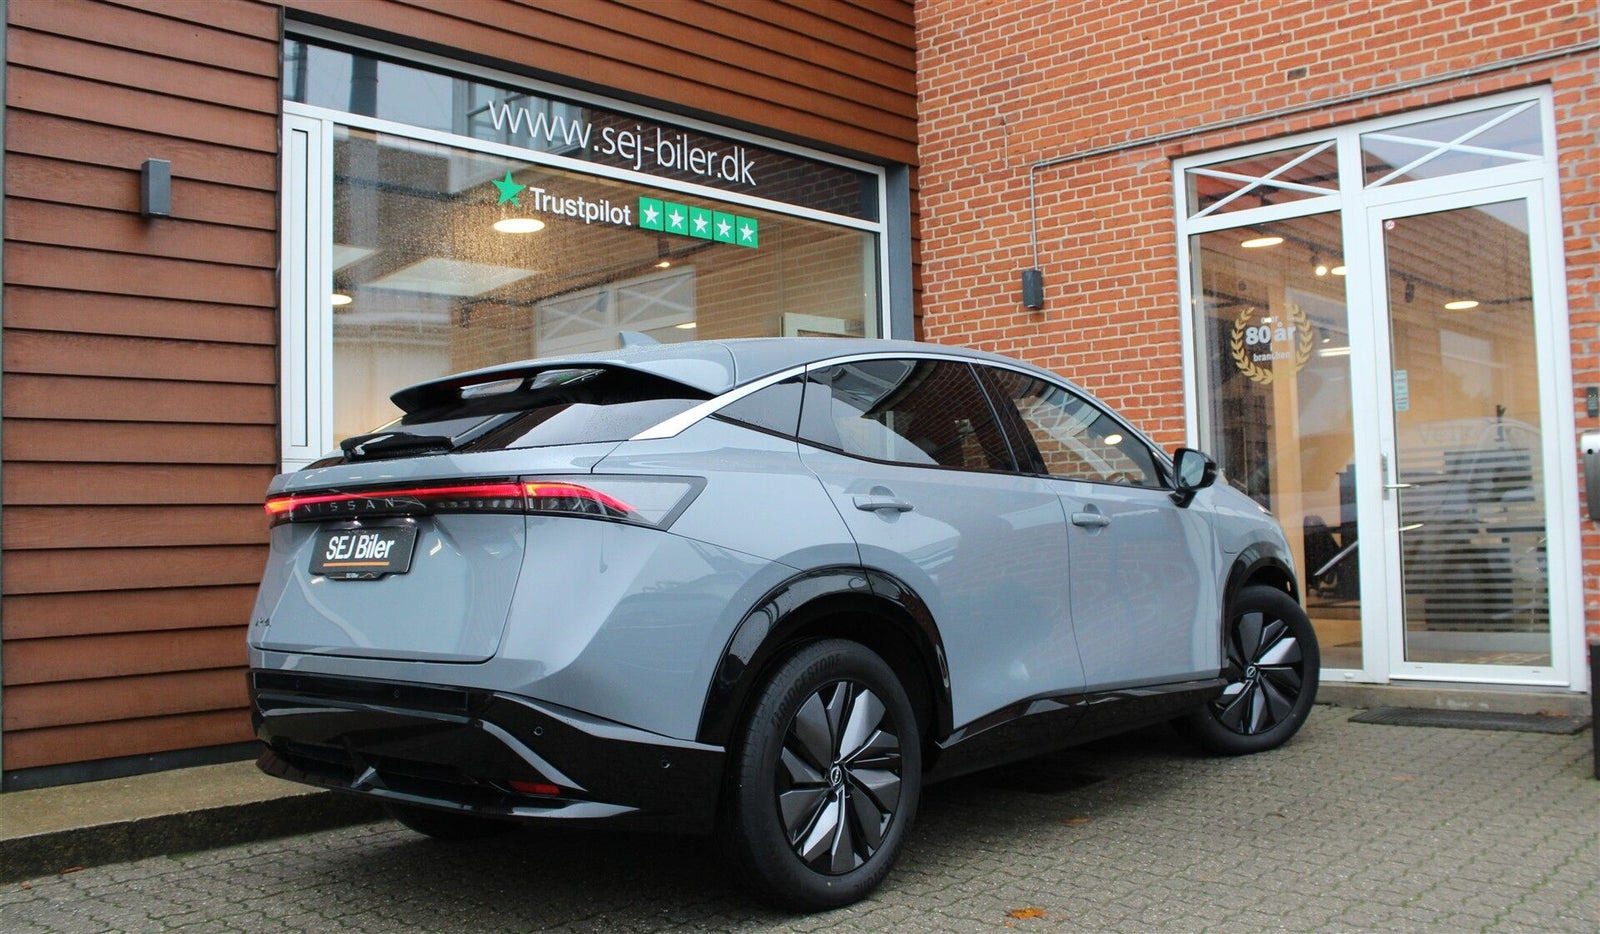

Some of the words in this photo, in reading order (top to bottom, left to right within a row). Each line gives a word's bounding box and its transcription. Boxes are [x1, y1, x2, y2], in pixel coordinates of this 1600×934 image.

[488, 100, 757, 186] www.sej-biler.dk
[529, 186, 632, 226] Trustpilot
[1245, 325, 1271, 345] 80
[1273, 321, 1297, 342] år
[303, 497, 395, 514] NISSAN
[325, 535, 355, 560] SEJ
[354, 533, 395, 560] Biler
